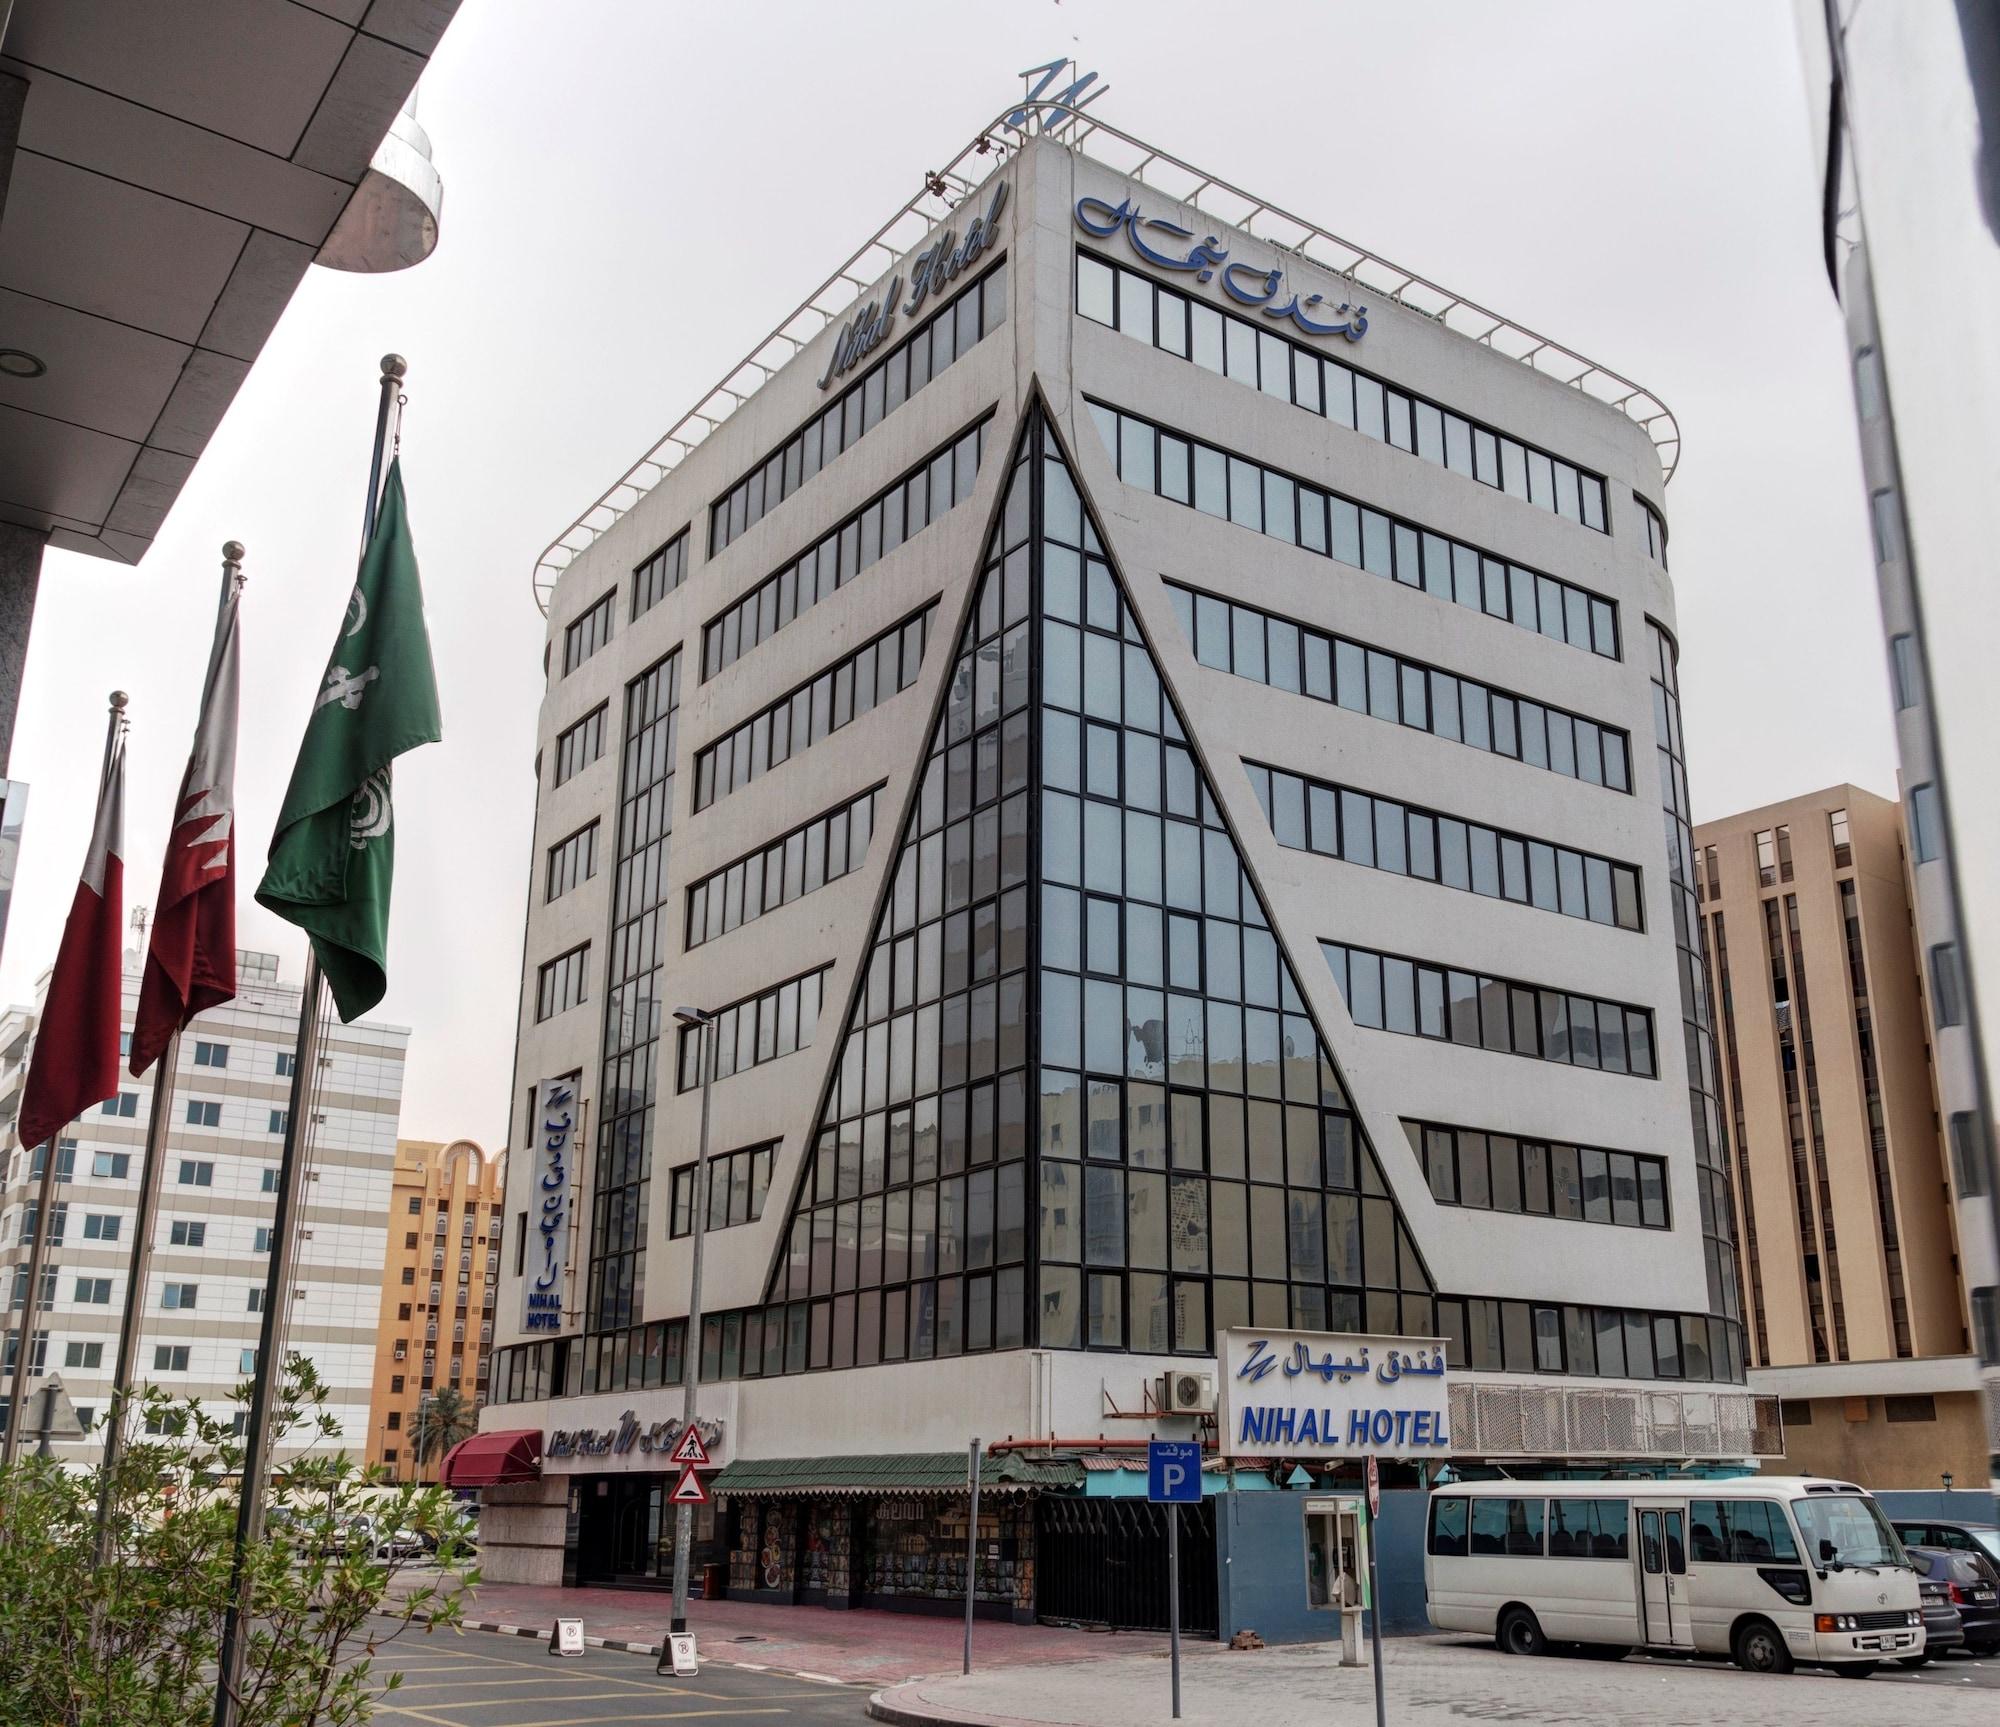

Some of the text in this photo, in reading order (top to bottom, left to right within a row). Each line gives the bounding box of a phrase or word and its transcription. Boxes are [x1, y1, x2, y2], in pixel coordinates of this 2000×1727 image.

[528, 1293, 562, 1311] NIHAL
[526, 1312, 561, 1329] HOTEL
[1283, 1341, 1370, 1383] نيهال
[1376, 1346, 1445, 1384] فندق
[1239, 1406, 1449, 1445] NIHAL HOTEL
[1156, 1443, 1193, 1460] موقف
[1163, 1463, 1185, 1496] P
